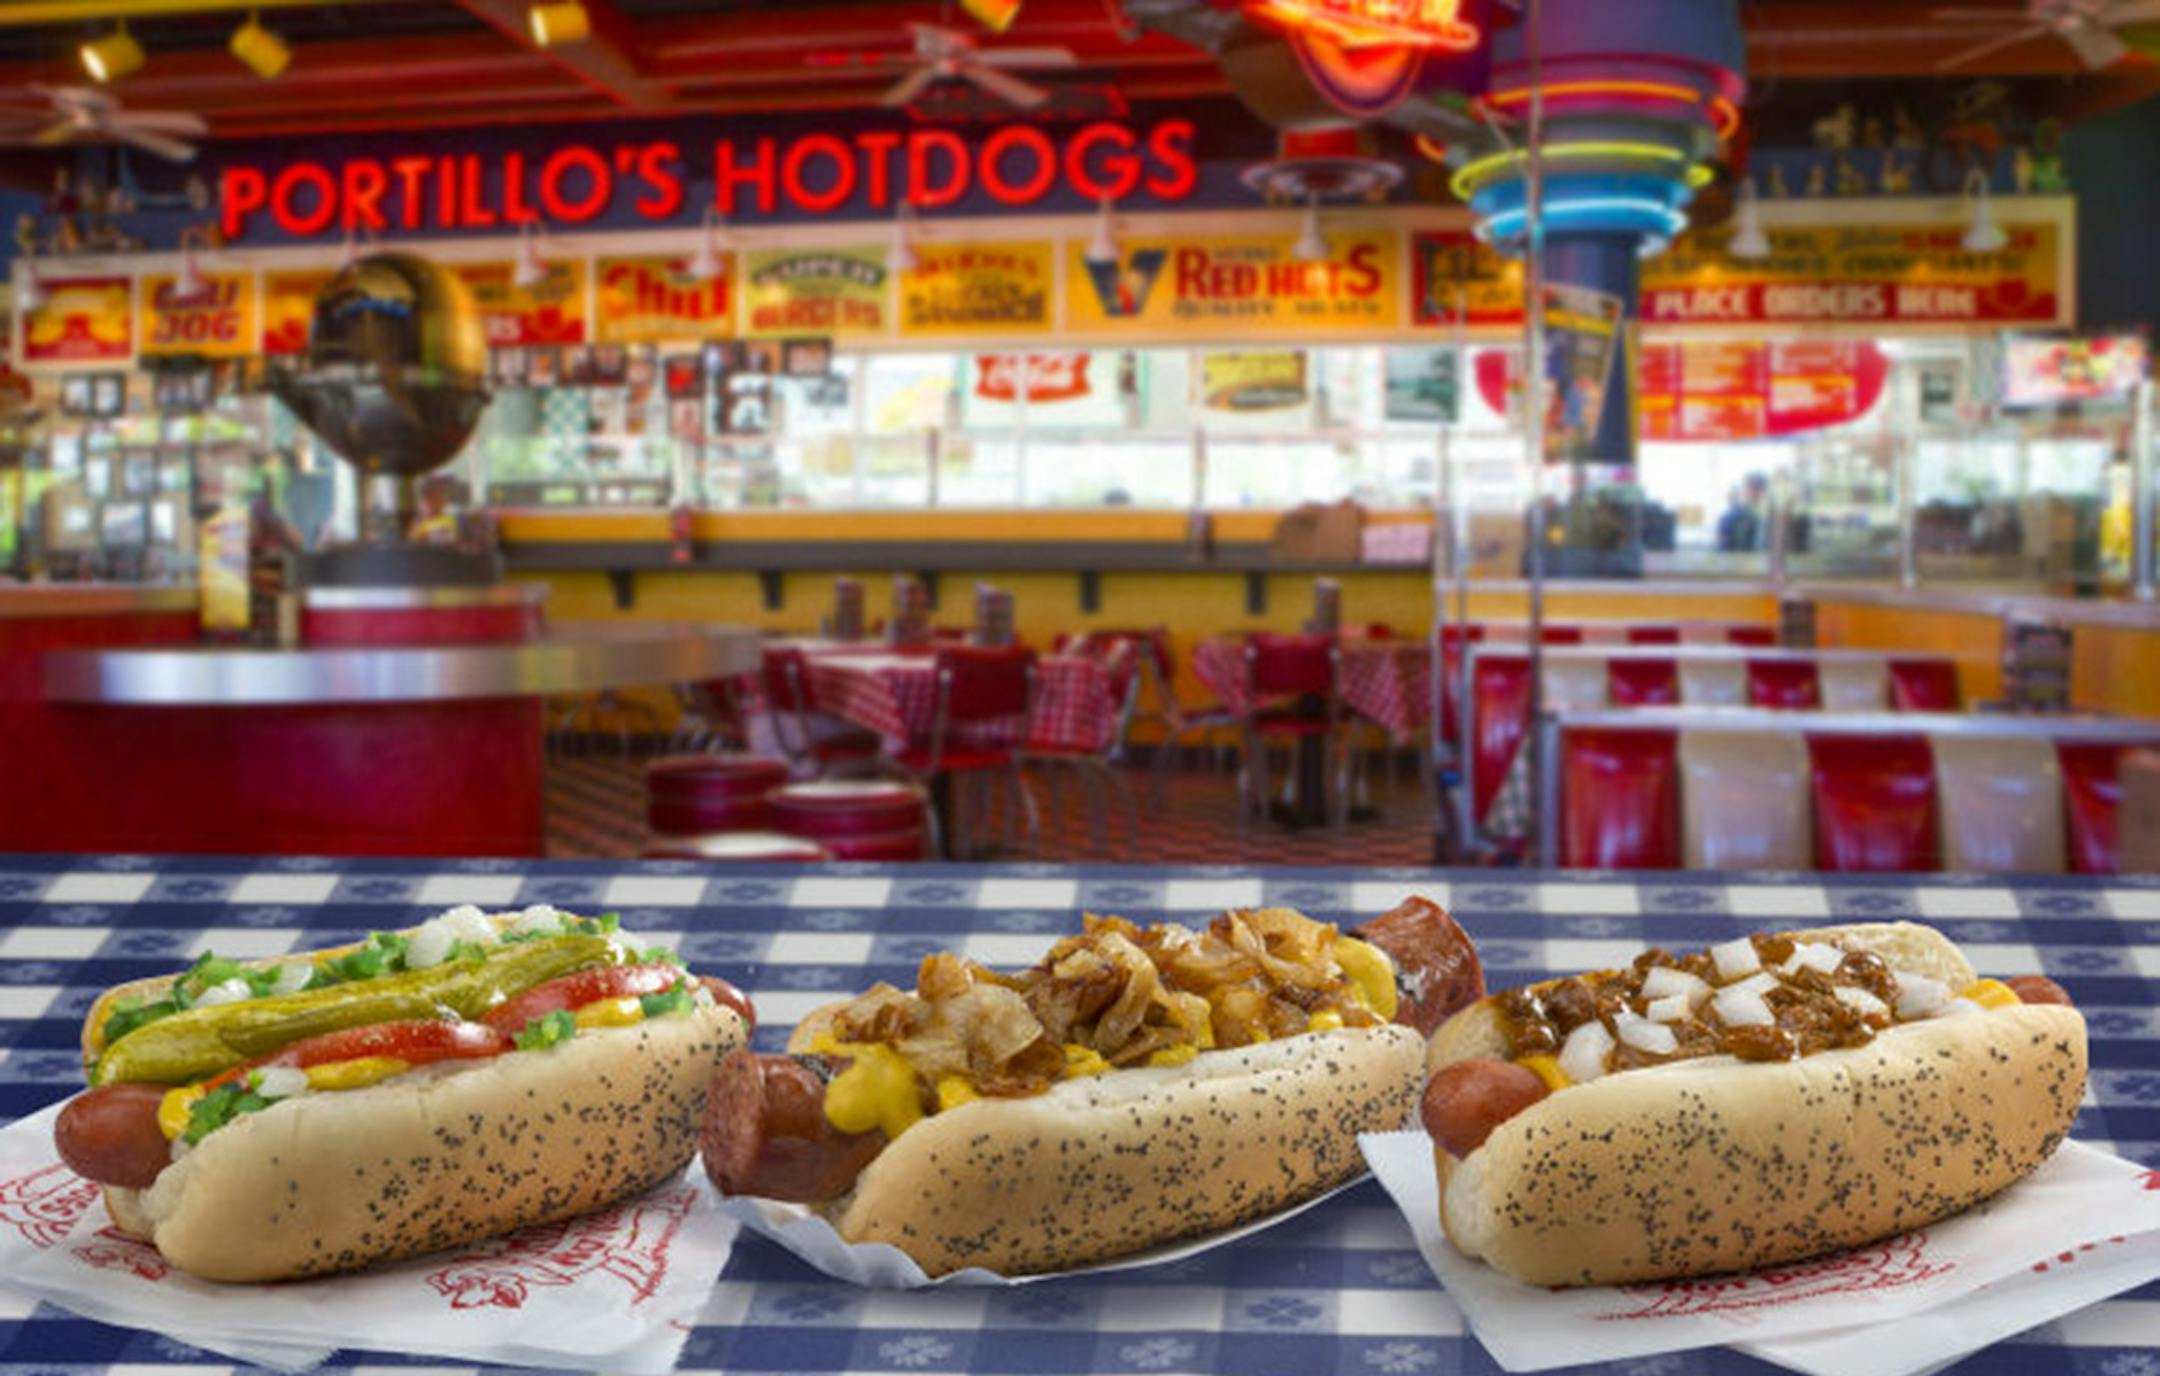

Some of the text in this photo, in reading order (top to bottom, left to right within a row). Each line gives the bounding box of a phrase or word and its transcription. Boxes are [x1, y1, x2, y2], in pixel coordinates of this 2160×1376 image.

[220, 120, 1197, 239] PORTILLO'S HOTDOGS
[1175, 246, 1258, 299] RED
[1267, 242, 1382, 299] HOTS
[1653, 284, 1978, 319] PLACE ORDERS HERE
